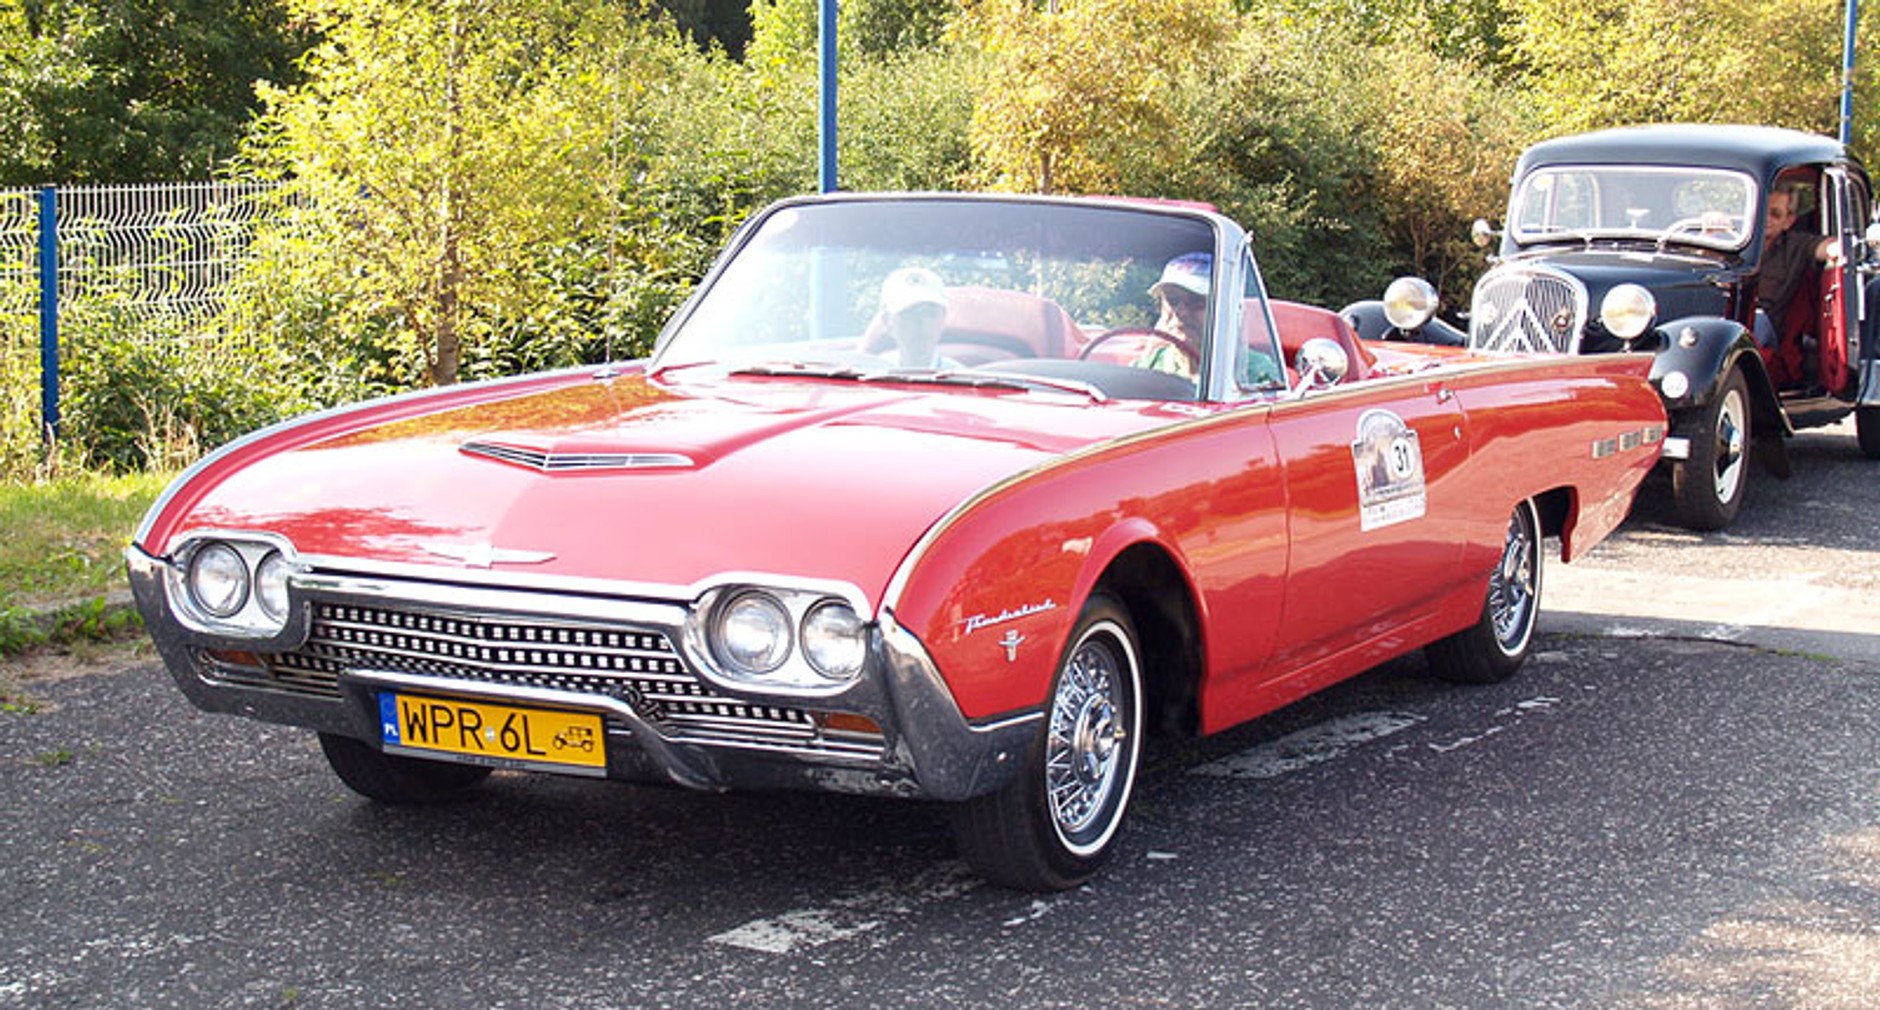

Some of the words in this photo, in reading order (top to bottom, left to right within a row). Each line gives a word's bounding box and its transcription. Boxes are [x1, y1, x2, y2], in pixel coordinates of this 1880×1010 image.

[1394, 443, 1412, 472] 31
[402, 700, 484, 750] WPR
[500, 712, 547, 756] 6L
